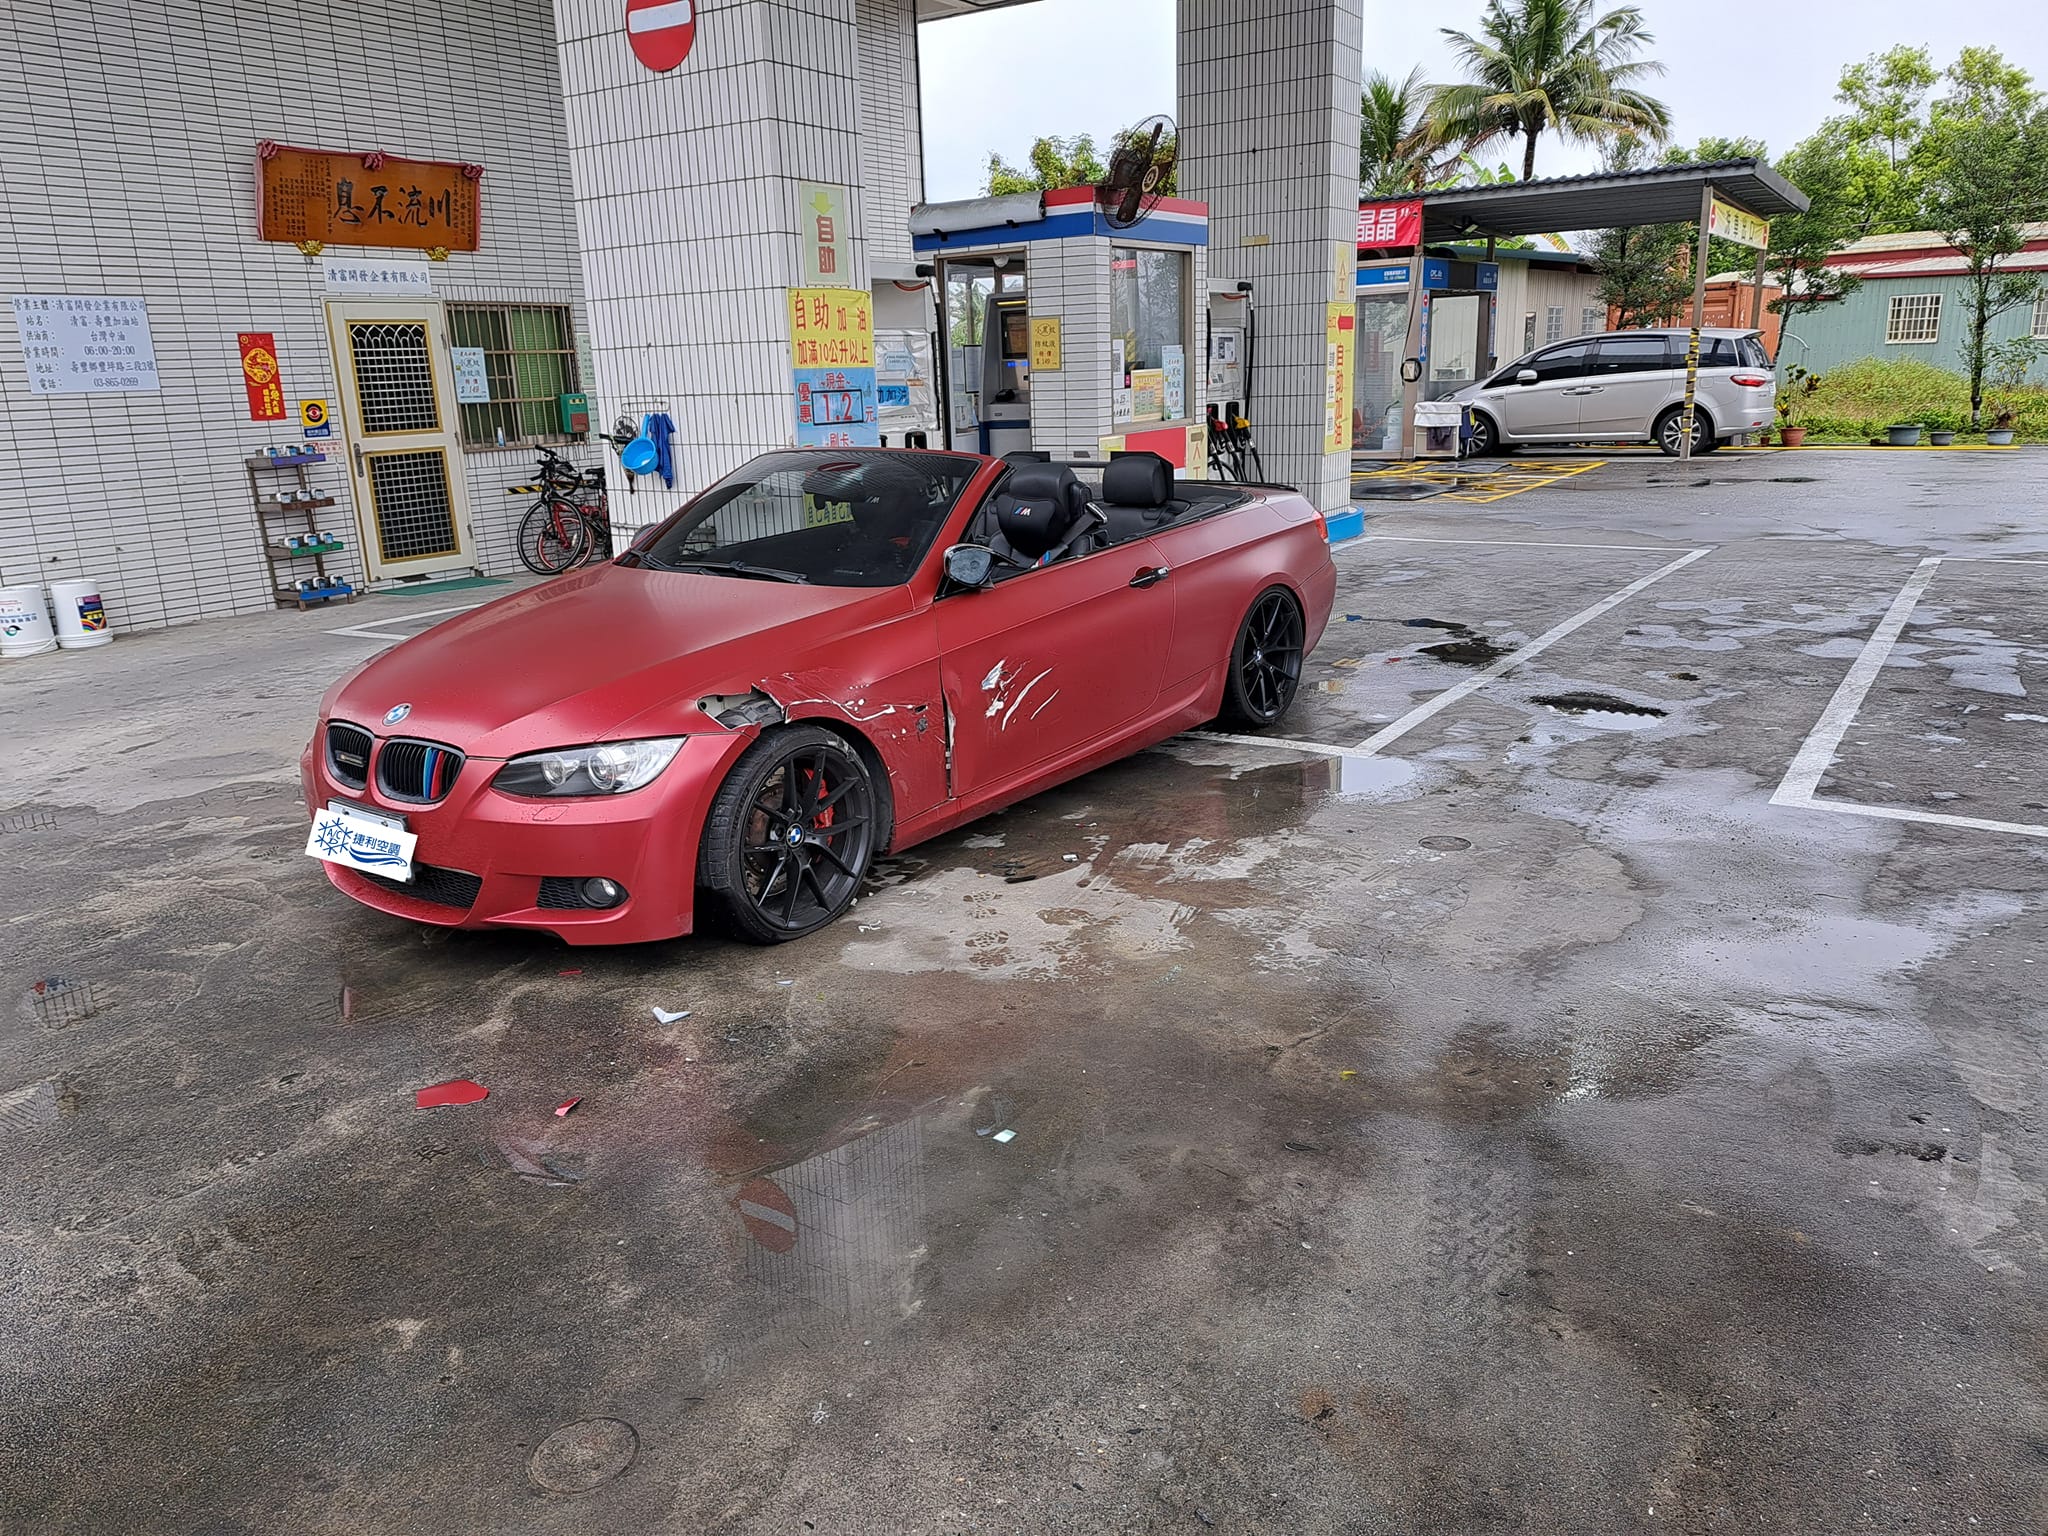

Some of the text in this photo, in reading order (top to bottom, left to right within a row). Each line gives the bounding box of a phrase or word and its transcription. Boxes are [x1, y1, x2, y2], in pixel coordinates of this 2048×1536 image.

[816, 214, 836, 274] 自助
[327, 269, 428, 283] 清富開發企業有限公司
[90, 331, 126, 341] 台灣中油
[84, 345, 136, 356] 06:00-20:00
[797, 339, 869, 365] 加滿10公升以上
[798, 382, 812, 423] 優惠
[823, 392, 853, 421] 1.2
[865, 406, 877, 423] 元
